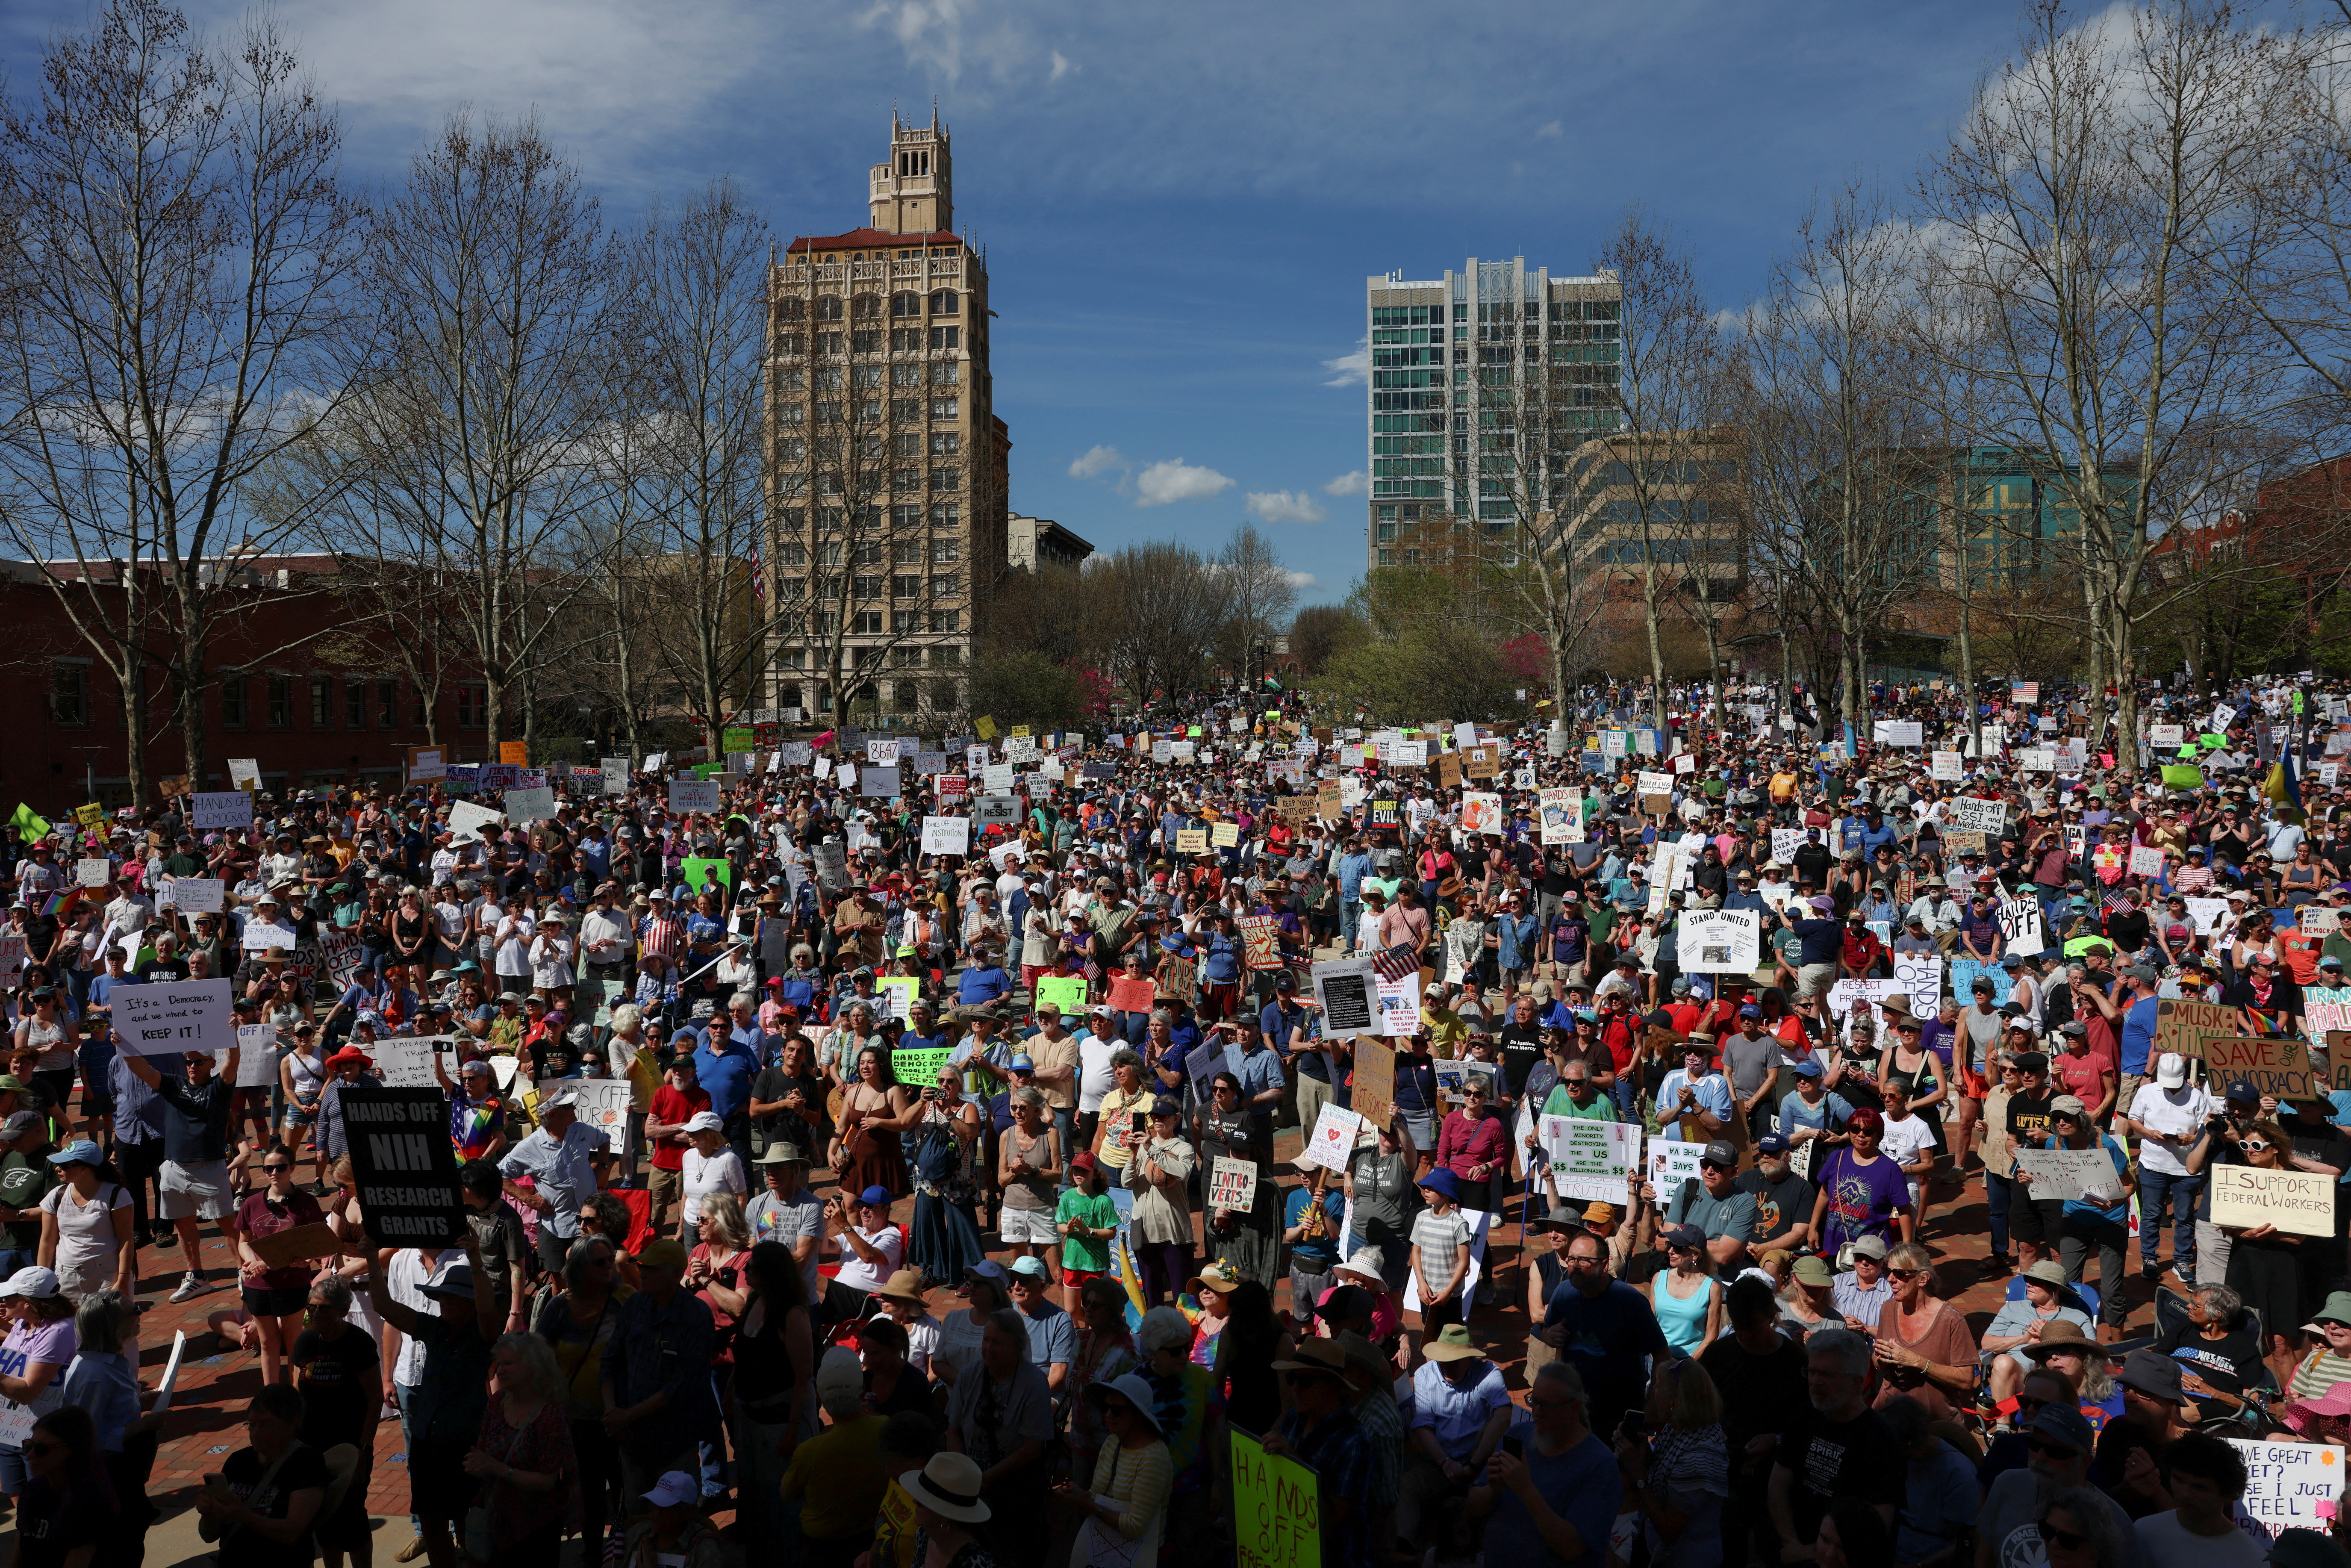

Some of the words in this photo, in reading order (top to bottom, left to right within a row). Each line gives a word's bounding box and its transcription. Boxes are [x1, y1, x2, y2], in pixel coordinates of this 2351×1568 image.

[1690, 722, 1698, 754] STAND
[489, 767, 505, 775] FIRE
[506, 766, 517, 775] THE
[490, 775, 516, 787] FELON!
[196, 797, 233, 811] HANDS
[236, 796, 252, 807] OFF
[509, 789, 540, 804] Good
[1324, 794, 1340, 802] LANDS
[79, 807, 100, 816] Hands
[515, 804, 552, 817] Trouble
[984, 808, 1013, 817] RESIST
[1373, 800, 1397, 811] RESIST
[1960, 798, 1984, 812] Hands
[1986, 803, 2003, 815] off
[198, 812, 252, 825] DEMOCRACY
[1373, 810, 1396, 823] EVIL
[1960, 811, 1983, 821] SSI
[1958, 820, 2001, 833] Medicare
[81, 860, 103, 869] Hear
[79, 873, 108, 884] Voice!
[1995, 896, 2037, 920] HANDS
[1239, 917, 1261, 928] FISTS
[1261, 915, 1272, 926] UP
[1690, 912, 1715, 926] STAND
[1720, 913, 1750, 928] UNITED
[1999, 910, 2037, 942] OFF
[245, 928, 295, 936] DEMOCRACY
[150, 971, 177, 981] HARRIS
[125, 998, 150, 1010] It's
[169, 994, 215, 1005] Democracy,
[131, 1013, 149, 1022] and
[166, 1009, 189, 1018] intend
[192, 1008, 204, 1016] to
[2174, 1002, 2223, 1028] MUSK
[141, 1028, 172, 1040] KEEP
[2211, 1041, 2276, 1067] SAVE
[2279, 1044, 2299, 1067] OUR
[347, 1102, 407, 1122] HANDS
[411, 1102, 439, 1122] OFF
[369, 1134, 433, 1170] NIH
[2218, 1167, 2238, 1185] I
[2239, 1172, 2328, 1196] SUPPORT
[365, 1187, 453, 1206] RESEARCH
[2217, 1191, 2269, 1207] FEDERAL
[2272, 1194, 2331, 1214] WORKERS
[381, 1216, 449, 1235] GRANTS
[2171, 1301, 2189, 1315] Coleman
